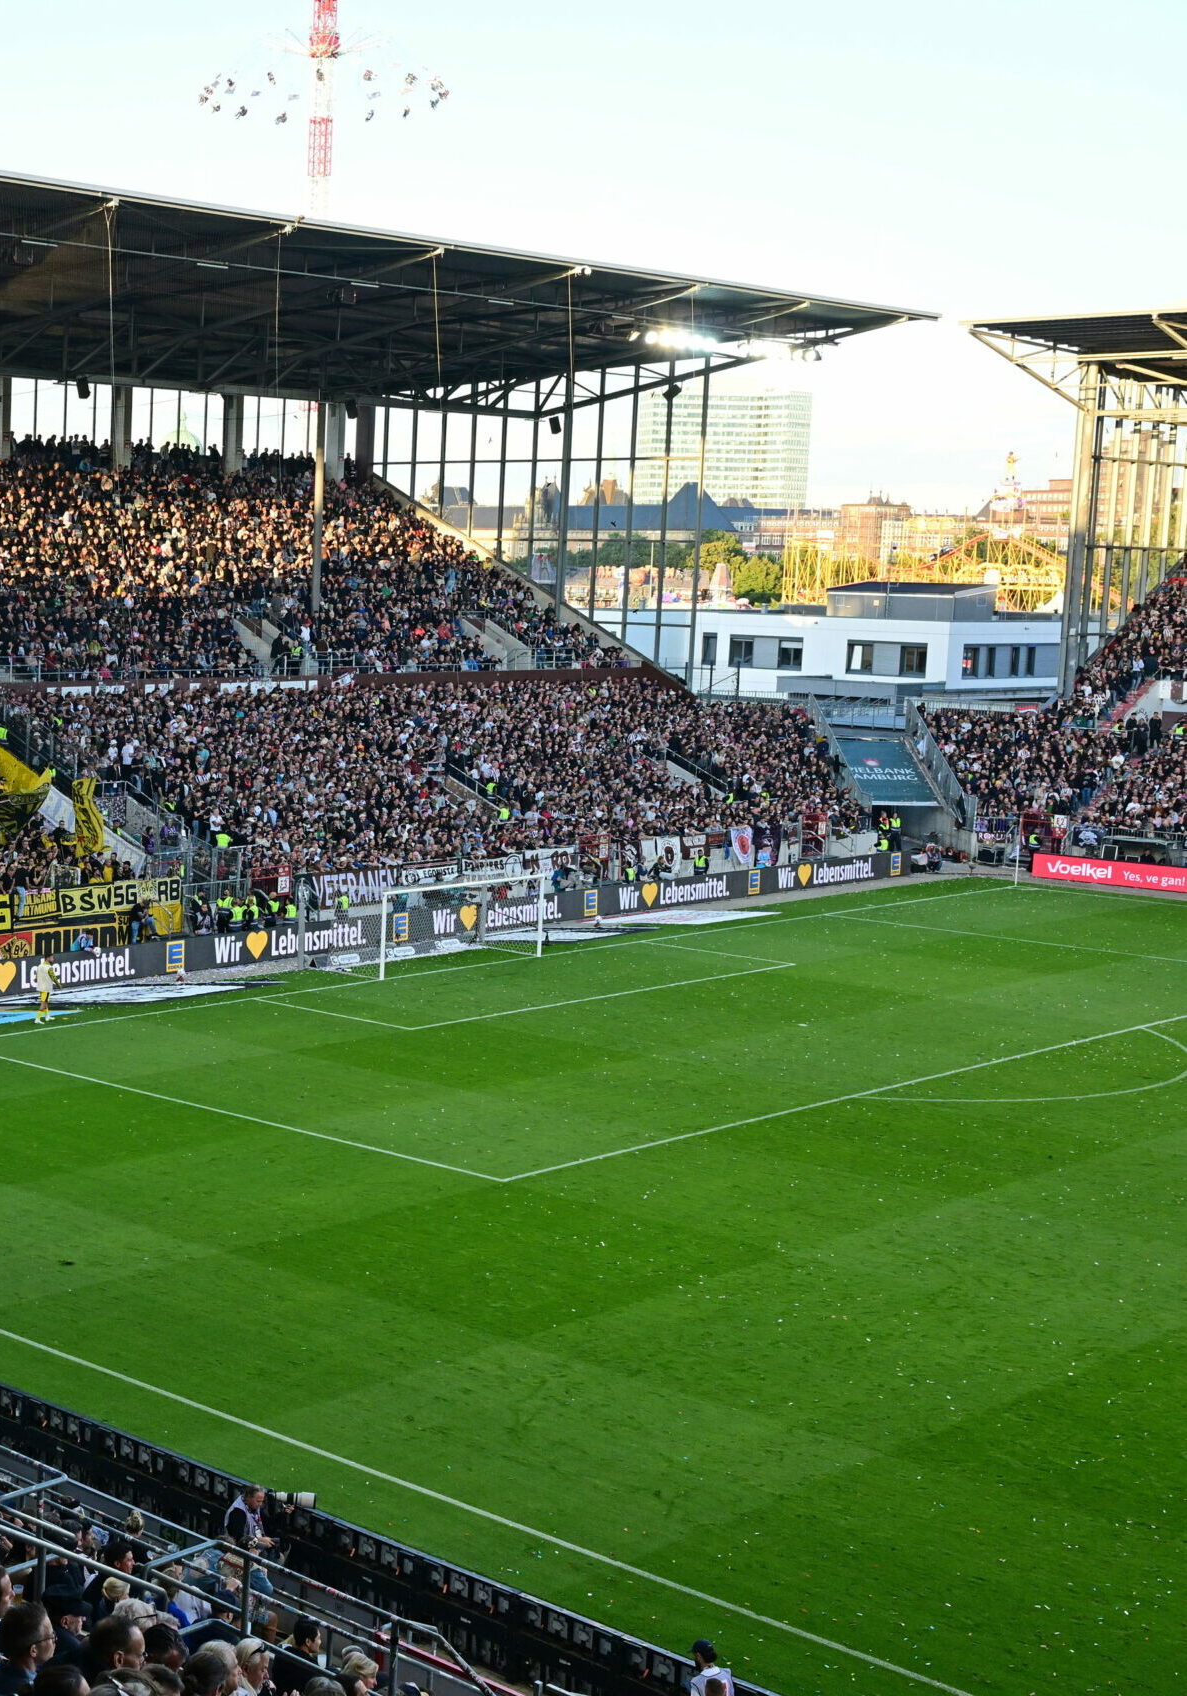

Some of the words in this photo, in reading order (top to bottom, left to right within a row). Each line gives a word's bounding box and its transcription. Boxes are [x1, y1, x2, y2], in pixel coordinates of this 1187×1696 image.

[777, 865, 796, 889] Wir
[812, 858, 875, 885] Lebensmittel.
[1046, 860, 1113, 880] Voelkel
[1123, 871, 1143, 883] Yes,
[1146, 875, 1159, 884] ve
[1160, 876, 1186, 887] gan!
[60, 884, 112, 913] BSW
[113, 883, 137, 907] SG
[618, 885, 640, 910] Wir
[659, 874, 730, 905] Lebensmittel.
[14, 900, 57, 918] DRTMUND
[432, 907, 457, 934] Wir
[213, 934, 243, 964] Wir
[20, 948, 136, 990] Leensmittel.
